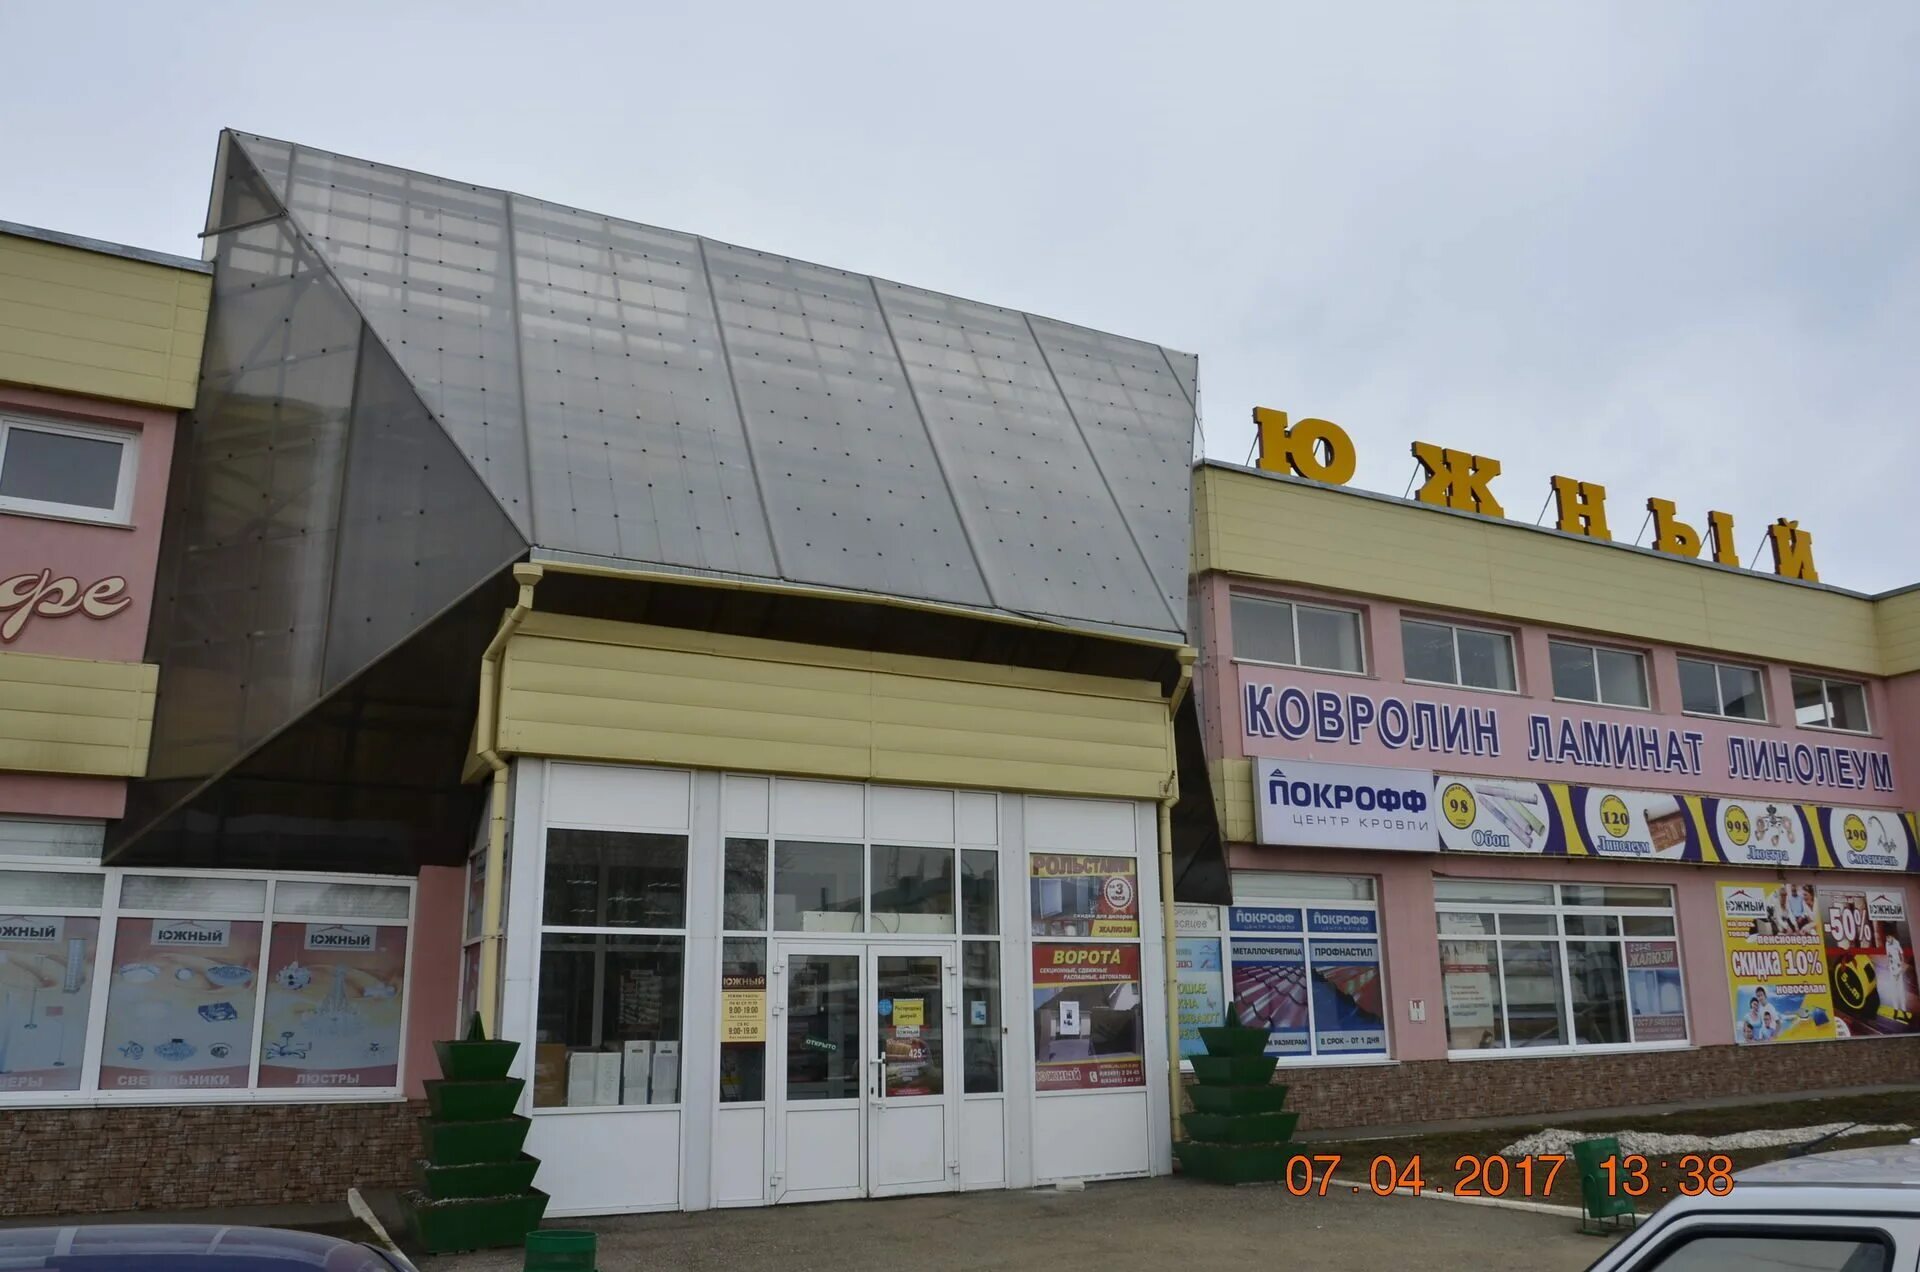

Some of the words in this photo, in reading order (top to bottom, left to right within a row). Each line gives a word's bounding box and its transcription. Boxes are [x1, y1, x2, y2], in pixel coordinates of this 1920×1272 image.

[1253, 407, 1819, 582] ЮЖНЫЙ
[1244, 681, 1501, 757] КОВРОЛИН
[1527, 713, 1704, 776] ЛАМИНАТ
[1728, 735, 1895, 791] ЛИНОЛЕУМ
[1269, 778, 1427, 814] ПОКРОФФ
[1450, 799, 1469, 814] 98
[1293, 814, 1350, 827] ЦЕНТР
[1359, 818, 1429, 831] КРОВЛИ
[1603, 812, 1629, 825] 120
[1727, 821, 1749, 833] 998
[1472, 829, 1510, 847] Обои
[1846, 829, 1867, 841] 290
[1597, 836, 1651, 856] Линолеум
[1746, 845, 1790, 864] Люстра
[1116, 883, 1124, 895] 3
[1726, 900, 1766, 912] ЮЖНЫЙ
[1869, 904, 1903, 915] ЮЖНЫЙ
[1236, 911, 1295, 924] ПОКРОФФ
[1313, 912, 1369, 925] ПОКРОФФ
[1824, 907, 1872, 942] -50%
[158, 929, 222, 942] ЮЖНЫЙ
[310, 933, 370, 946] ЮЖНЫЙ
[1757, 935, 1821, 947] пенсионерам
[1053, 949, 1121, 964] ВОРОТА
[1233, 947, 1302, 956] МЕТАЛЛОЧЕРЕПИЦА
[1315, 947, 1373, 957] ПРОФНАСТИЛ
[1784, 949, 1823, 976] 10%
[724, 976, 765, 986] ЮЖНЫЙ
[805, 1039, 837, 1050] ОТКРЫТО
[295, 1073, 360, 1085] ЛЮСТРЫ
